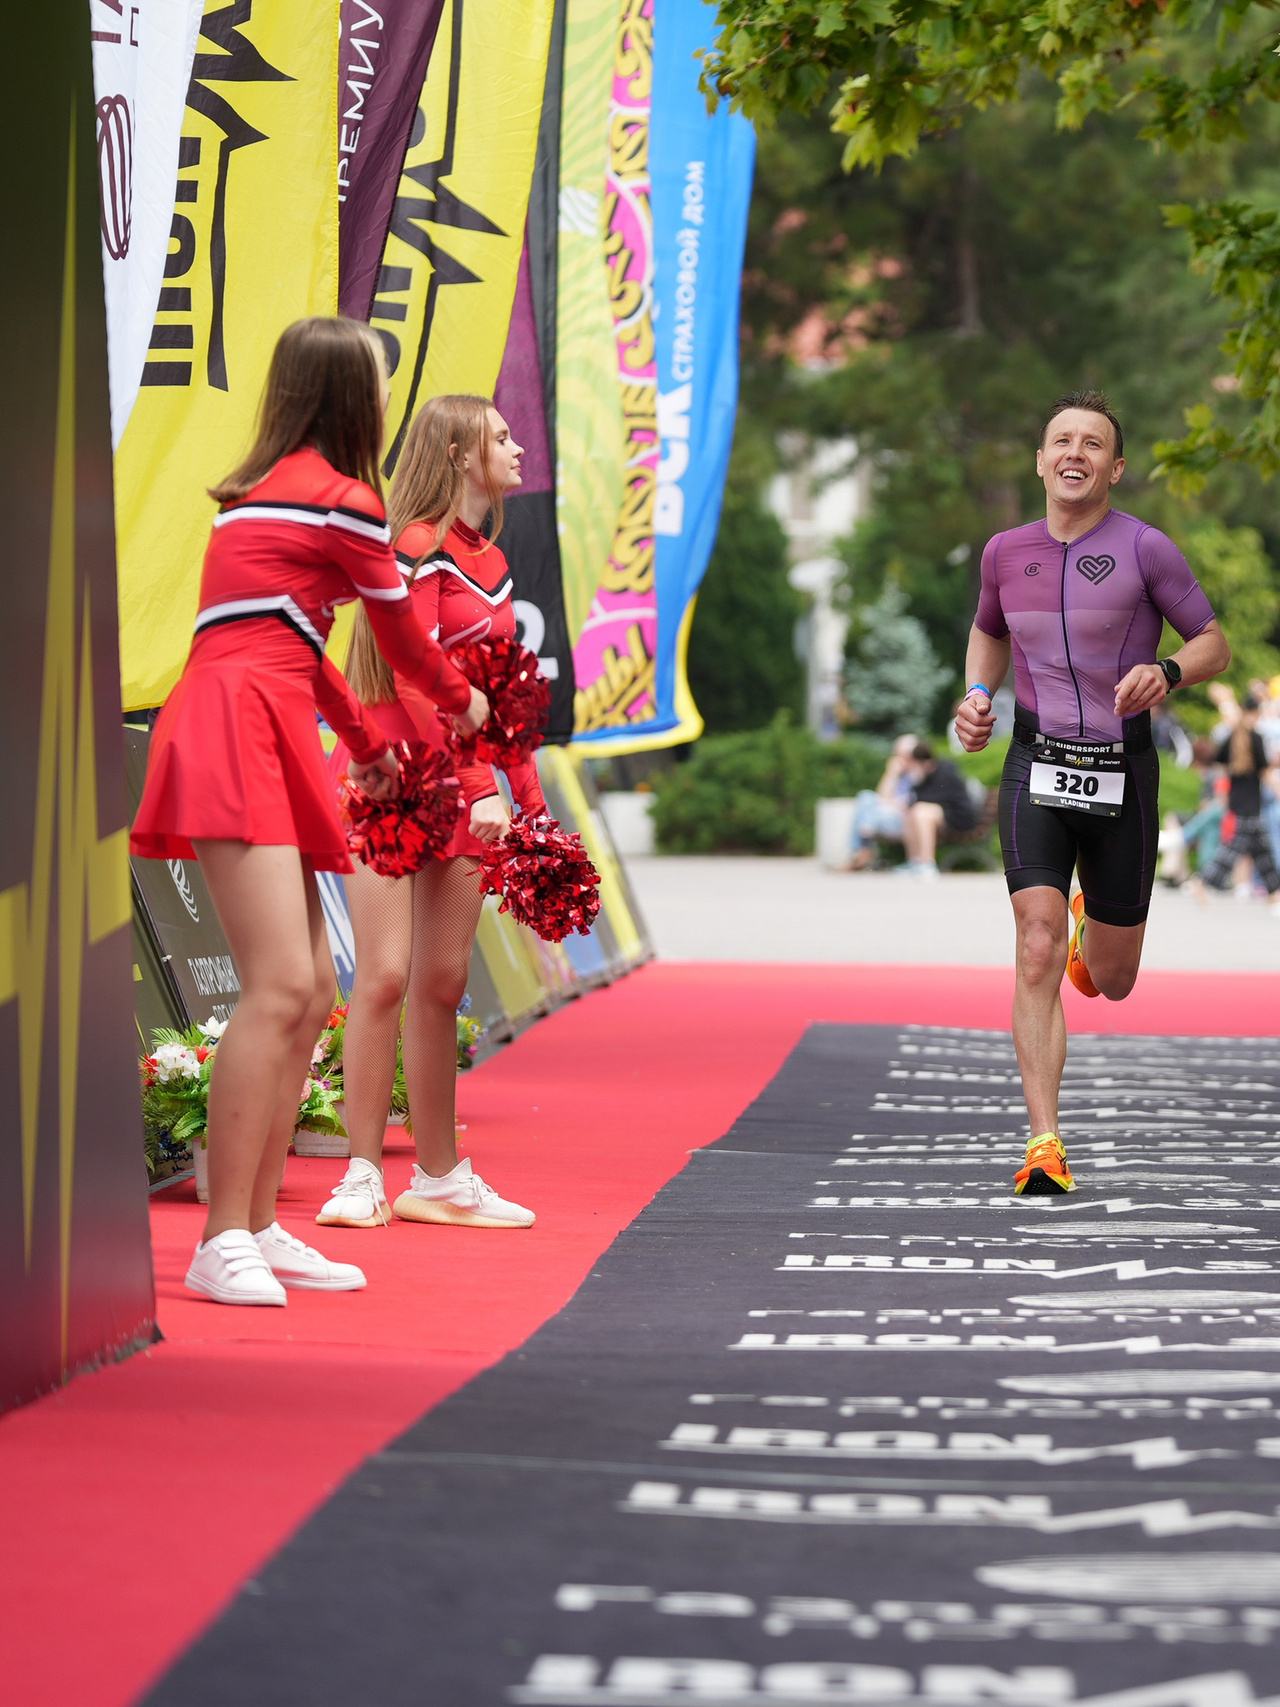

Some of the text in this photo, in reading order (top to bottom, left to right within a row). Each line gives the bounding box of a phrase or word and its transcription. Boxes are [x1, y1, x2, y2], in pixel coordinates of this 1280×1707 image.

[681, 161, 706, 226] ДОМ
[671, 228, 700, 382] СТРАХОВОЙ
[1055, 742, 1111, 753] SUPERSPORT
[1053, 771, 1099, 797] 320
[1060, 798, 1091, 810] VLADIMIR
[811, 1196, 1053, 1206] IRON
[782, 1254, 1057, 1270] IRON
[738, 1333, 1056, 1346] IRON
[669, 1422, 1054, 1454] IRON
[627, 1480, 1052, 1519] IRON
[525, 1653, 1076, 1702] IRON
